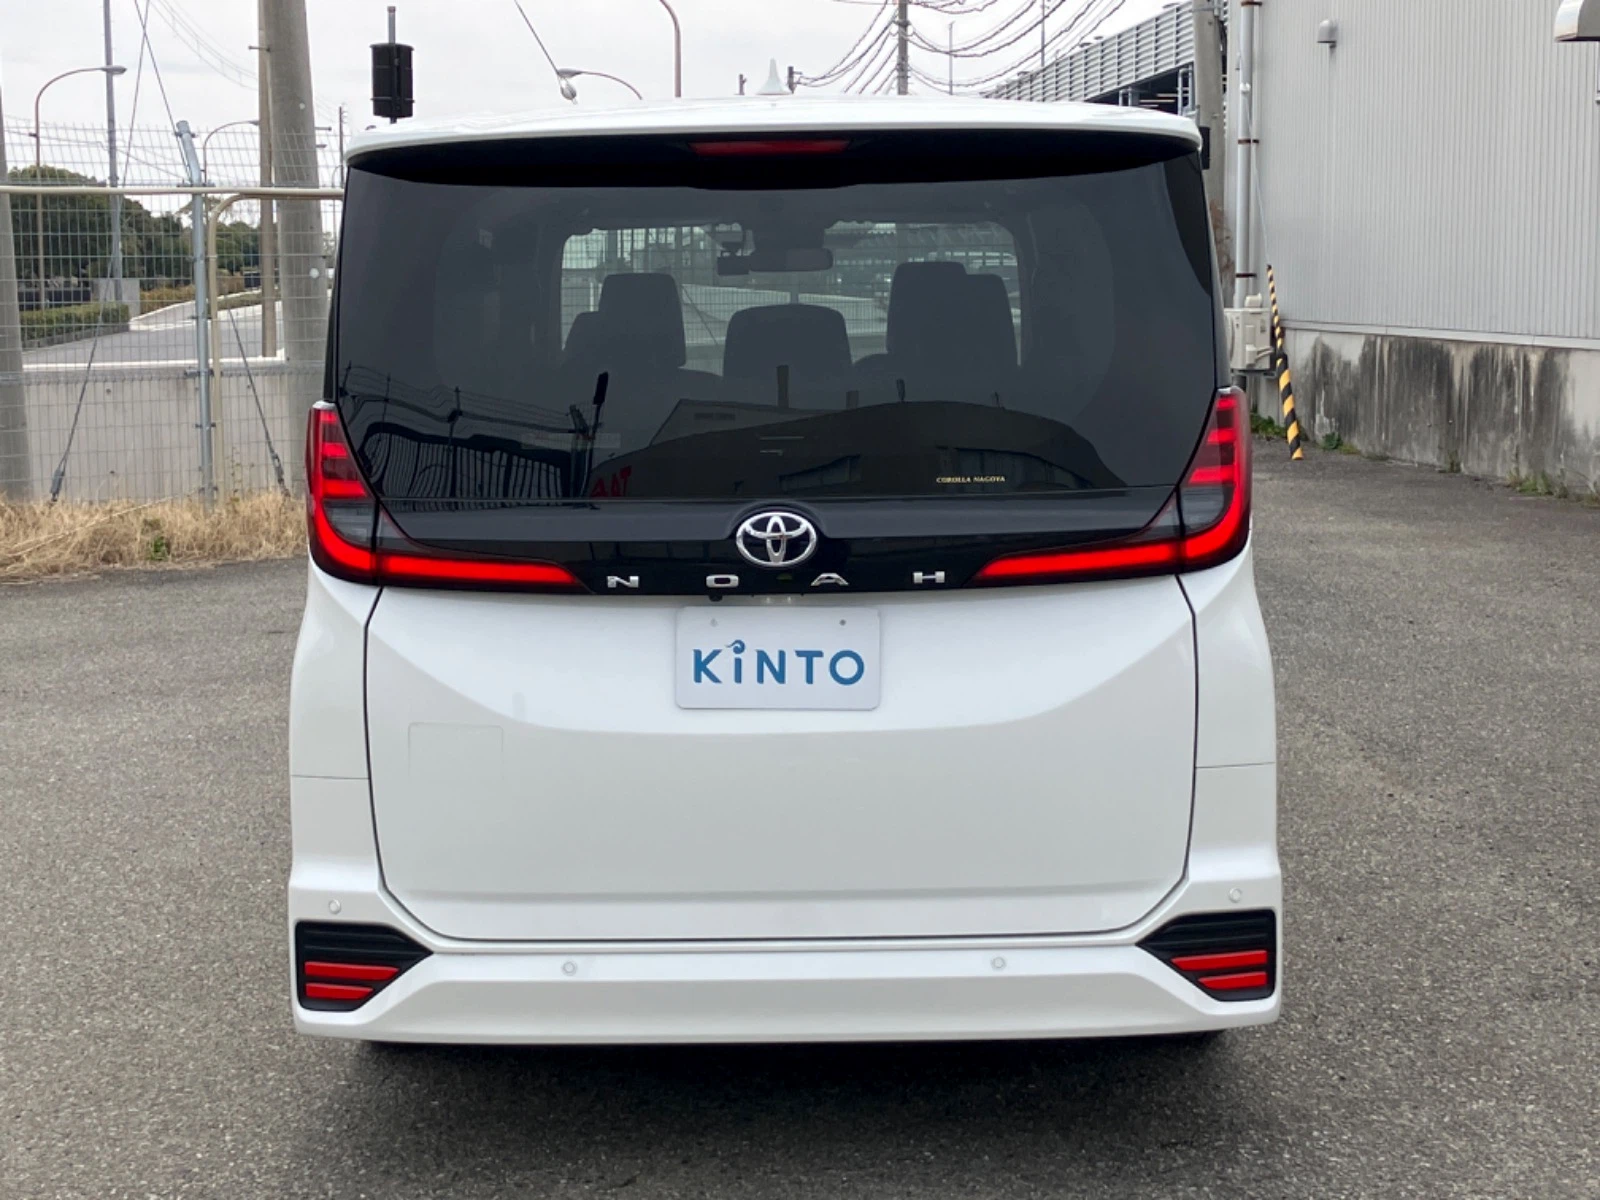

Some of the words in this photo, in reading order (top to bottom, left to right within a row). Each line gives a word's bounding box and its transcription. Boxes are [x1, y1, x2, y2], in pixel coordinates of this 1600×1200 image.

[935, 476, 971, 484] COROLLA
[973, 475, 1006, 483] NAGOYA
[606, 571, 946, 589] NOAH
